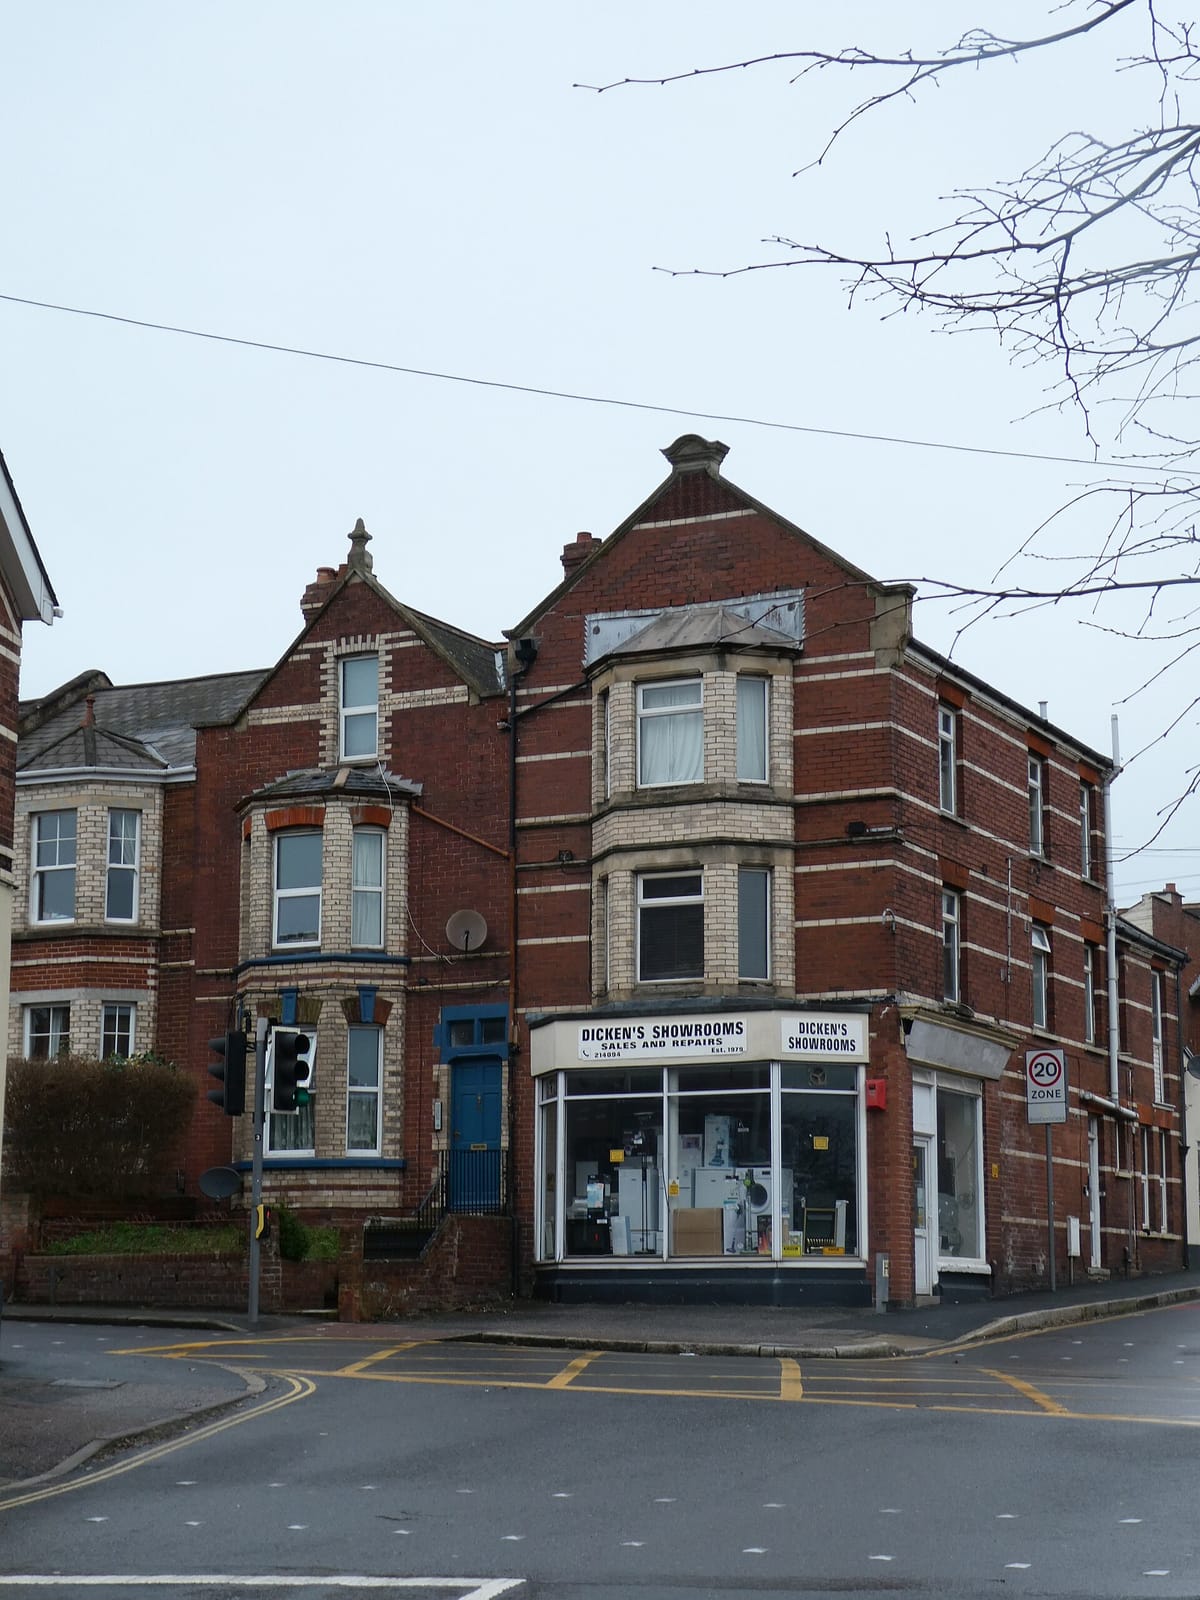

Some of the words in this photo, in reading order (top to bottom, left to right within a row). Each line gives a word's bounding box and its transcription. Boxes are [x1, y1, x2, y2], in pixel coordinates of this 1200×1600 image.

[582, 1026, 645, 1042] DICKEN'S
[652, 1021, 744, 1039] SHOWROOMS
[799, 1022, 848, 1036] DICKEN'S
[601, 1041, 637, 1050] SALES
[641, 1040, 666, 1049] AND
[672, 1037, 723, 1047] REPAIRS
[788, 1036, 856, 1052] SHOWROOMS
[1034, 1062, 1057, 1077] 20
[1031, 1089, 1062, 1099] ZONE
